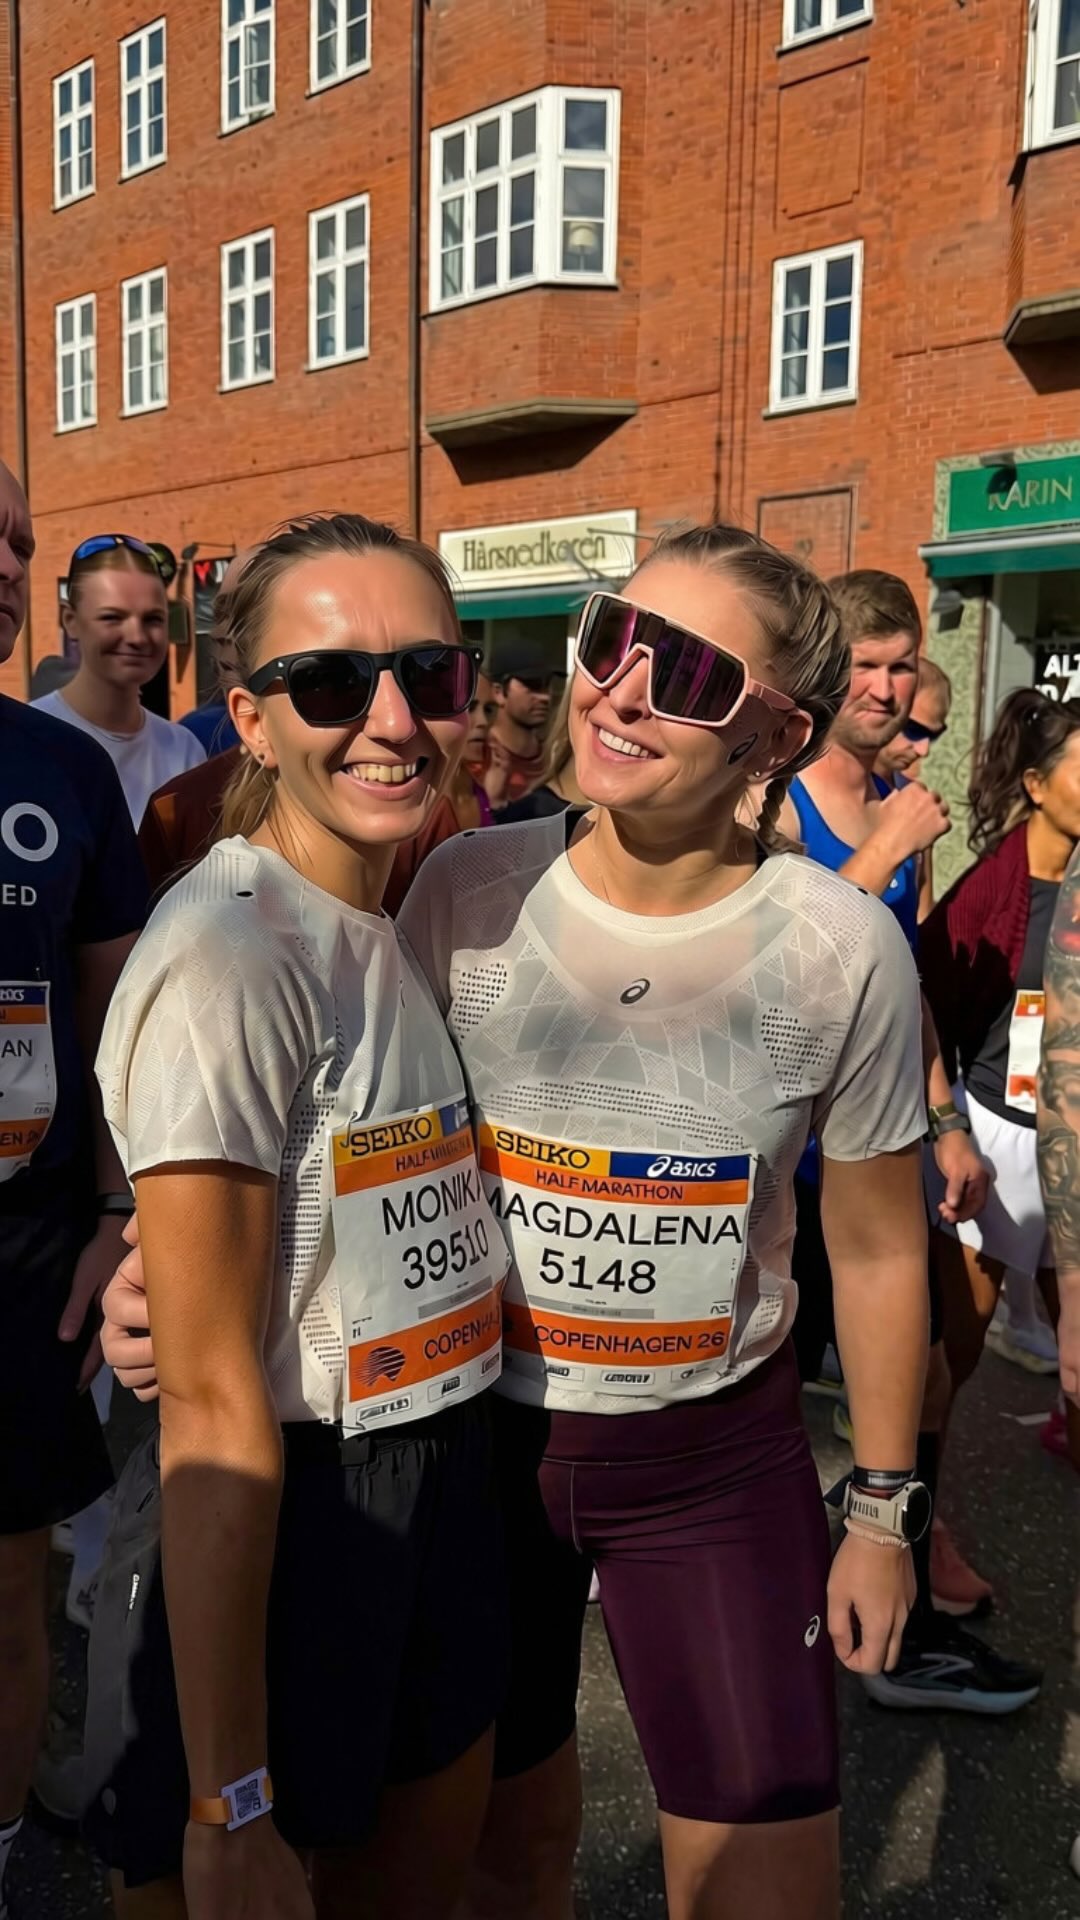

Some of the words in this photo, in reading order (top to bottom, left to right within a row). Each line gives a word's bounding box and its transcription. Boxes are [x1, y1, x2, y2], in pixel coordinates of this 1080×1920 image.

[350, 1116, 433, 1157] SEIKO
[496, 1130, 591, 1170] SEIKO
[535, 1170, 580, 1189] HALF
[581, 1177, 684, 1200] MARATHON
[402, 1218, 489, 1290] 39510
[539, 1248, 656, 1294] 5148
[534, 1325, 691, 1354] COPENHAGEN
[696, 1330, 726, 1348] 26
